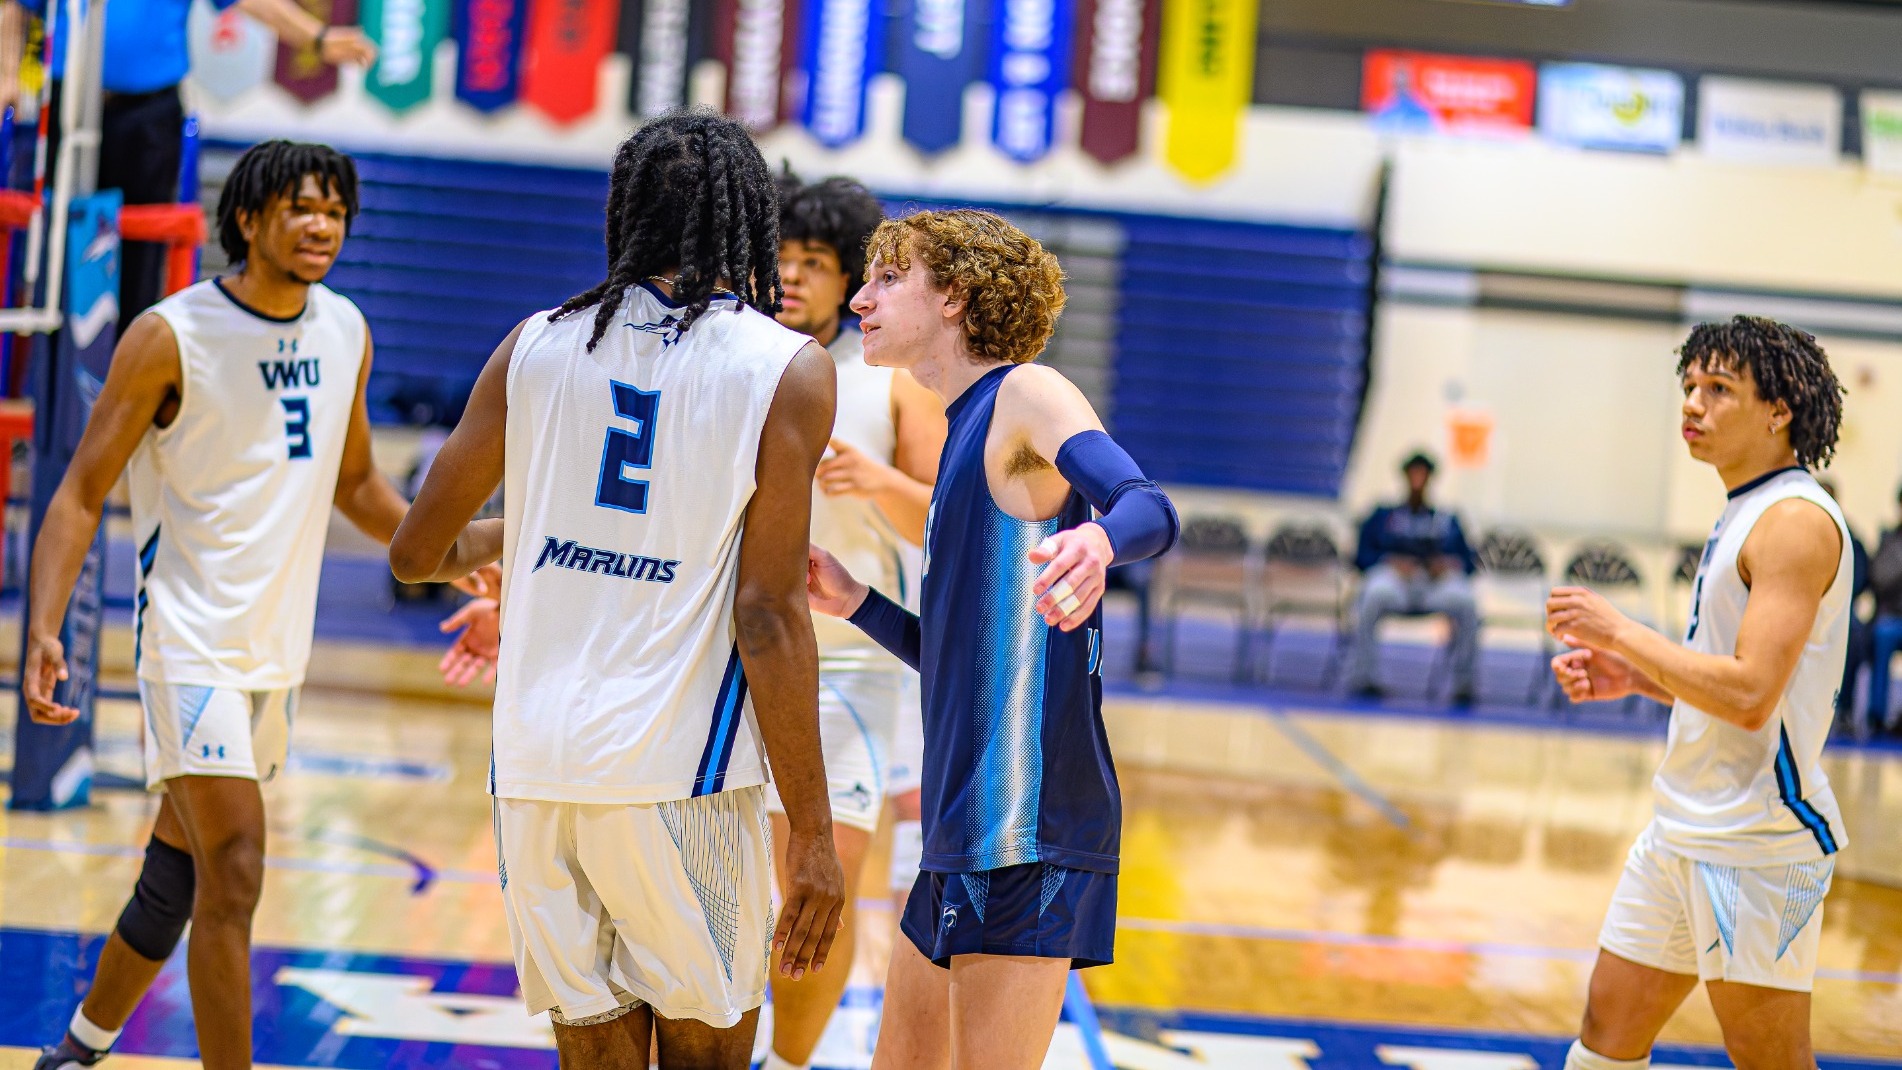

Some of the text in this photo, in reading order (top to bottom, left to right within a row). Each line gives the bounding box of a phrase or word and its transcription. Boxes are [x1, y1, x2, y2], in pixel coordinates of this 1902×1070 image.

[258, 359, 320, 390] VWU
[280, 397, 313, 460] 3
[594, 378, 662, 515] 2
[531, 535, 682, 584] MARLINS
